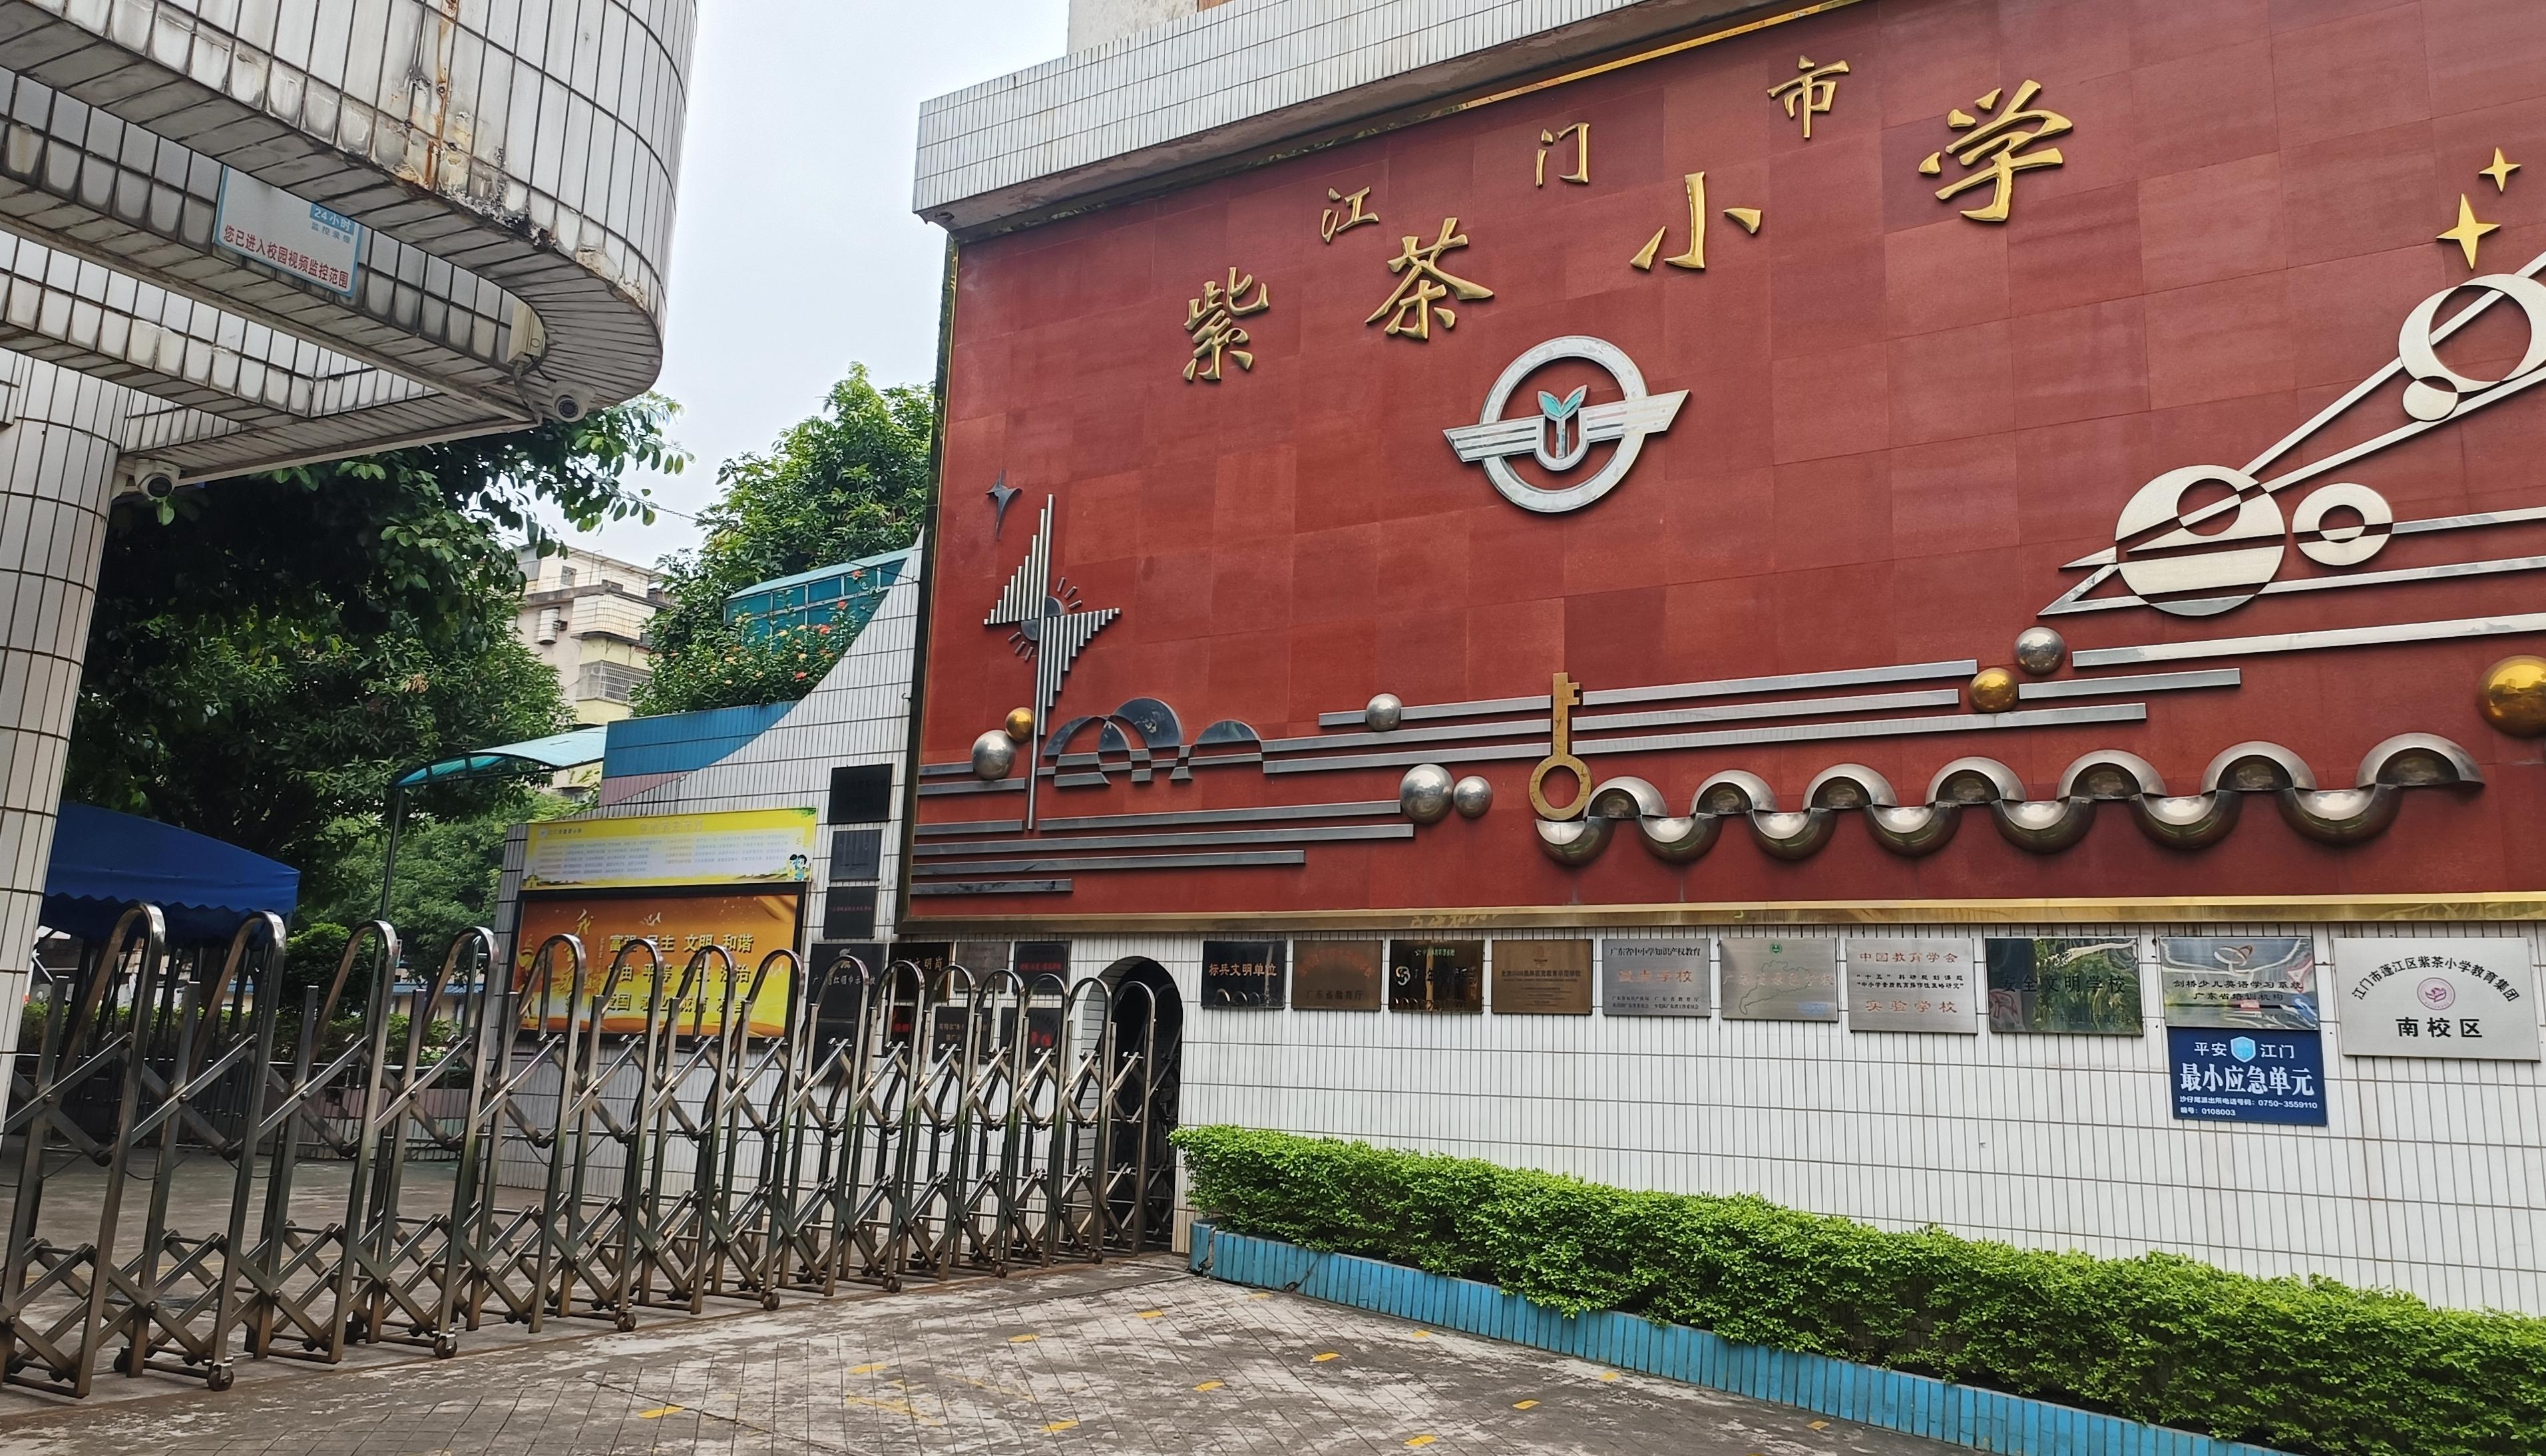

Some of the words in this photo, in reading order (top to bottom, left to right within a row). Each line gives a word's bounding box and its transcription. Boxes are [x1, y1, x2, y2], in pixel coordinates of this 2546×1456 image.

[314, 208, 351, 231] 24小时
[1182, 79, 2073, 381] 紫茶小学
[224, 224, 349, 289] 您已进入校园视频监控范围
[722, 934, 754, 952] 和谐
[1860, 952, 1958, 964] 中国教育学会
[1208, 963, 1277, 977] 标兵文明单位
[2351, 956, 2521, 1002] 江门市蓬江区紫茶小学教育集团
[2002, 974, 2126, 994] 安全文明学校
[1865, 1000, 1958, 1013] 实验学校
[2193, 992, 2284, 1001] 广东省培训机构
[2395, 1017, 2483, 1038] 南校区
[2194, 1041, 2227, 1057] 平安
[2260, 1043, 2295, 1059] 江门
[2179, 1062, 2315, 1096] 最小应急单元
